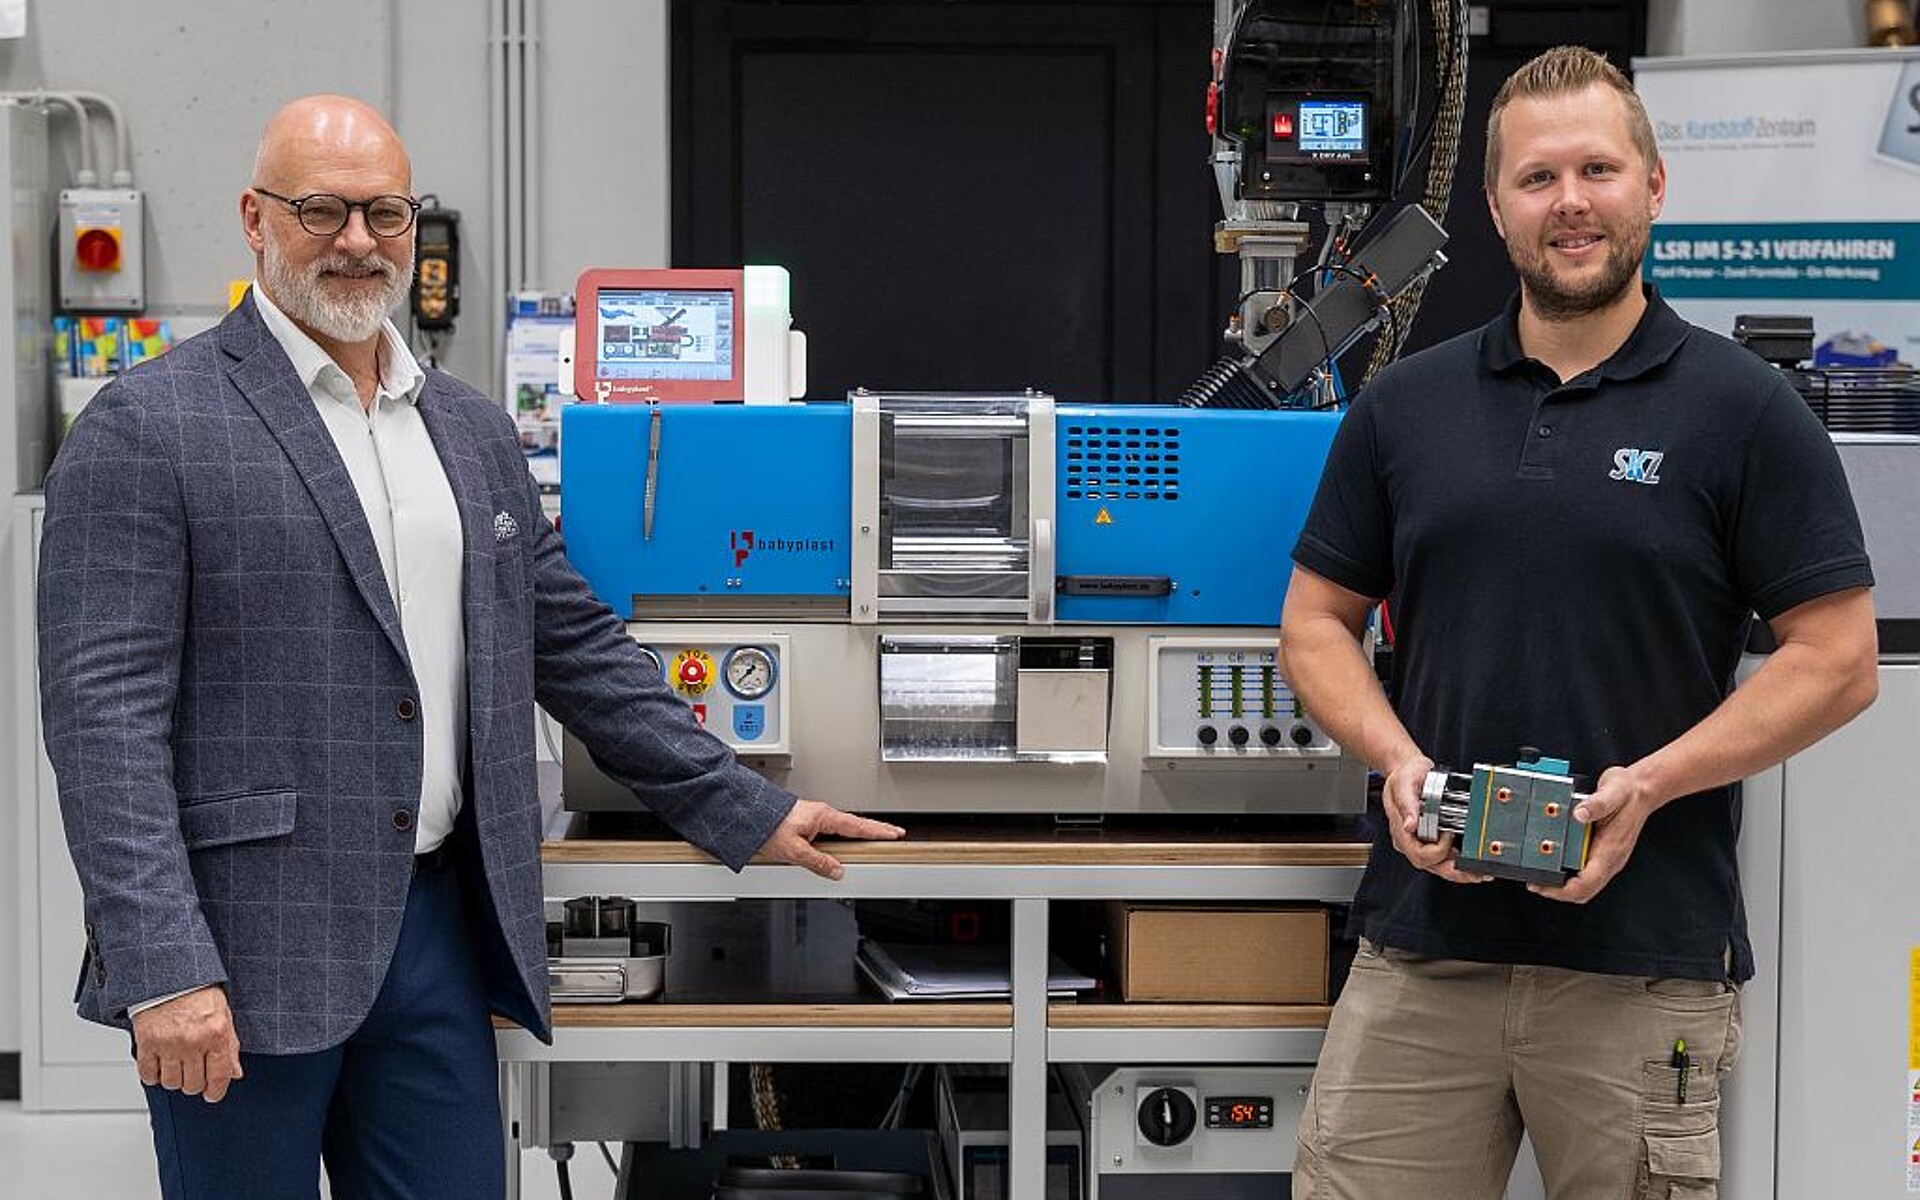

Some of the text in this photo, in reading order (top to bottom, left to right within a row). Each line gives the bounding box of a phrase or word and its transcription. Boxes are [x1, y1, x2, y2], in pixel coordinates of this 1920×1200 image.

[1653, 240, 1691, 260] LSR
[1693, 240, 1720, 260] IM
[1773, 239, 1894, 260] VERFAHREN
[1608, 448, 1665, 485] SKZ
[758, 539, 834, 552] babyplast
[678, 649, 709, 662] STOP
